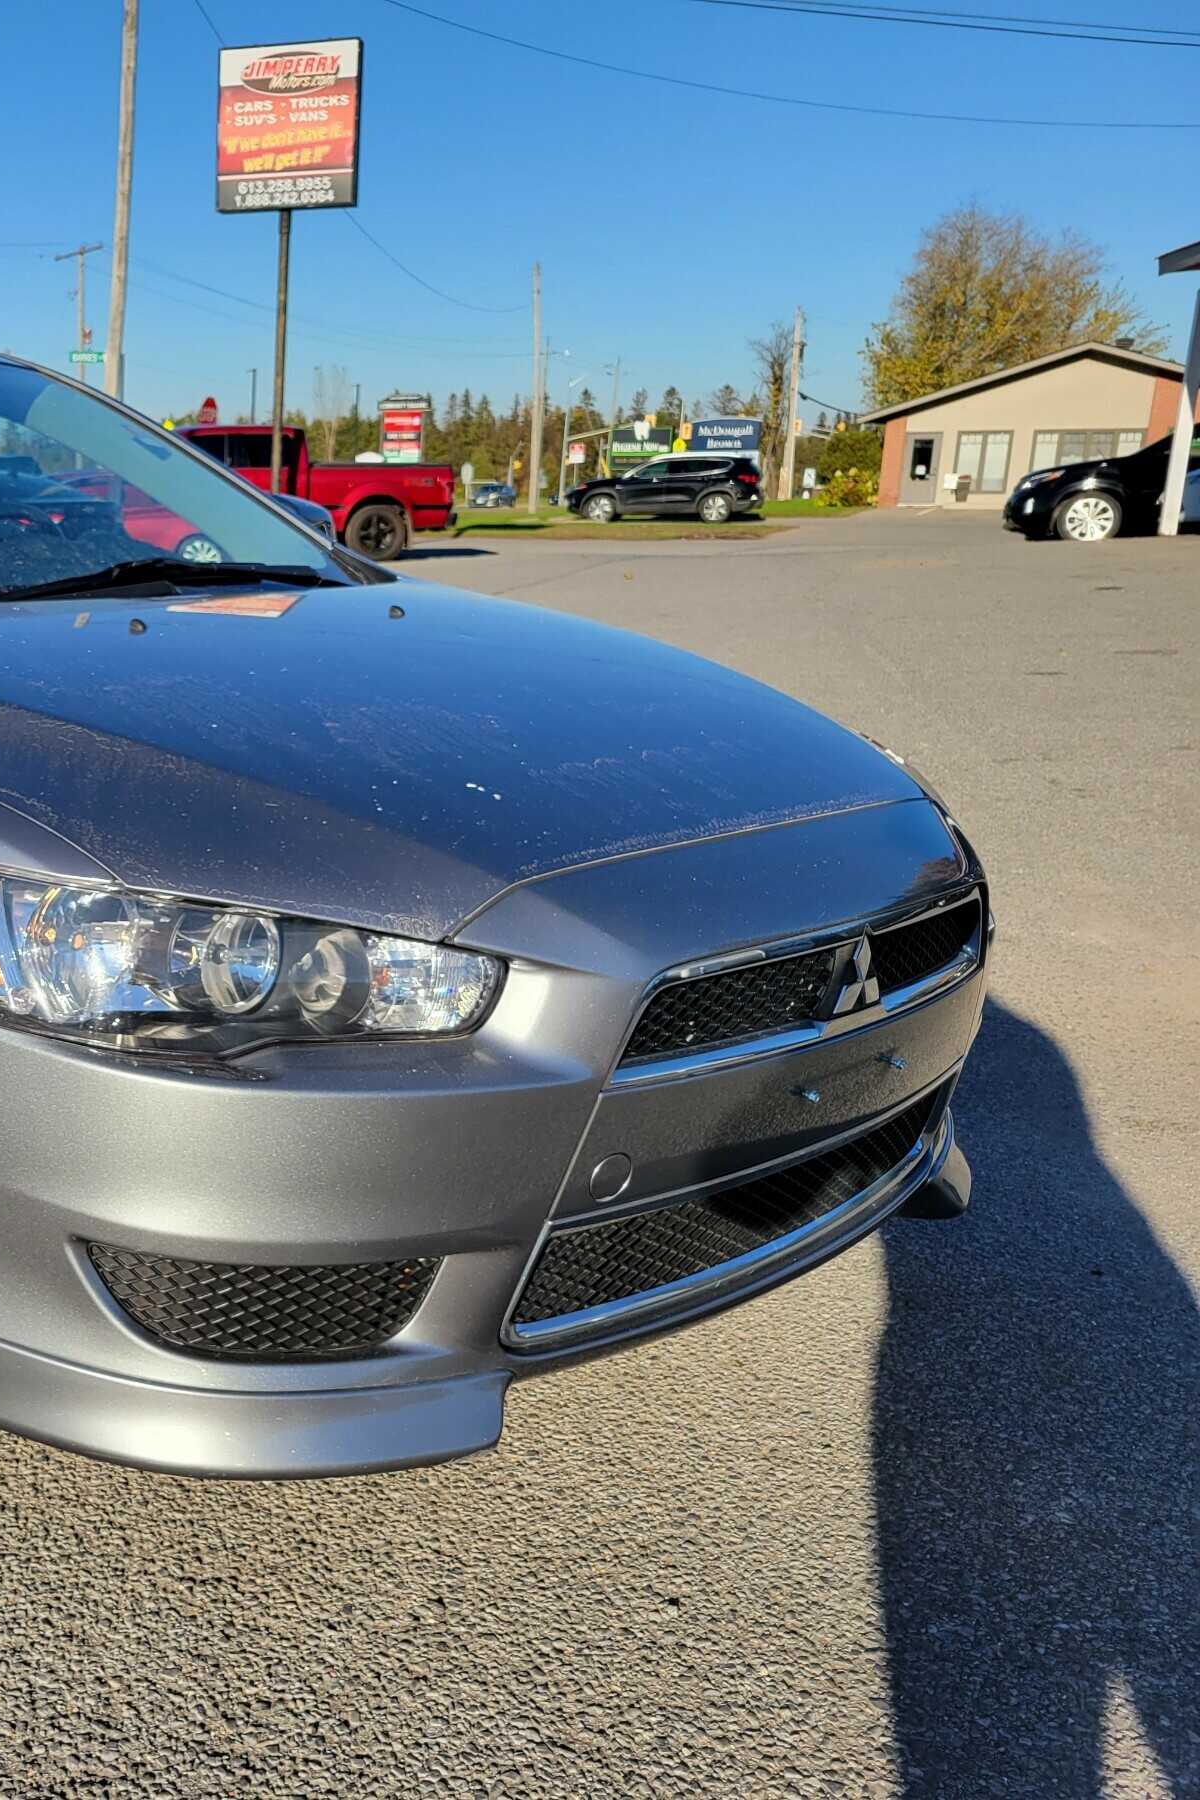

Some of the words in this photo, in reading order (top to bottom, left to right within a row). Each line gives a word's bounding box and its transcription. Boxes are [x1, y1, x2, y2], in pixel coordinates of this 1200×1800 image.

[244, 59, 280, 79] JIM
[281, 55, 341, 77] PERRY
[234, 100, 273, 114] CARS
[289, 94, 350, 109] TRUCKS
[289, 110, 329, 123] VANS
